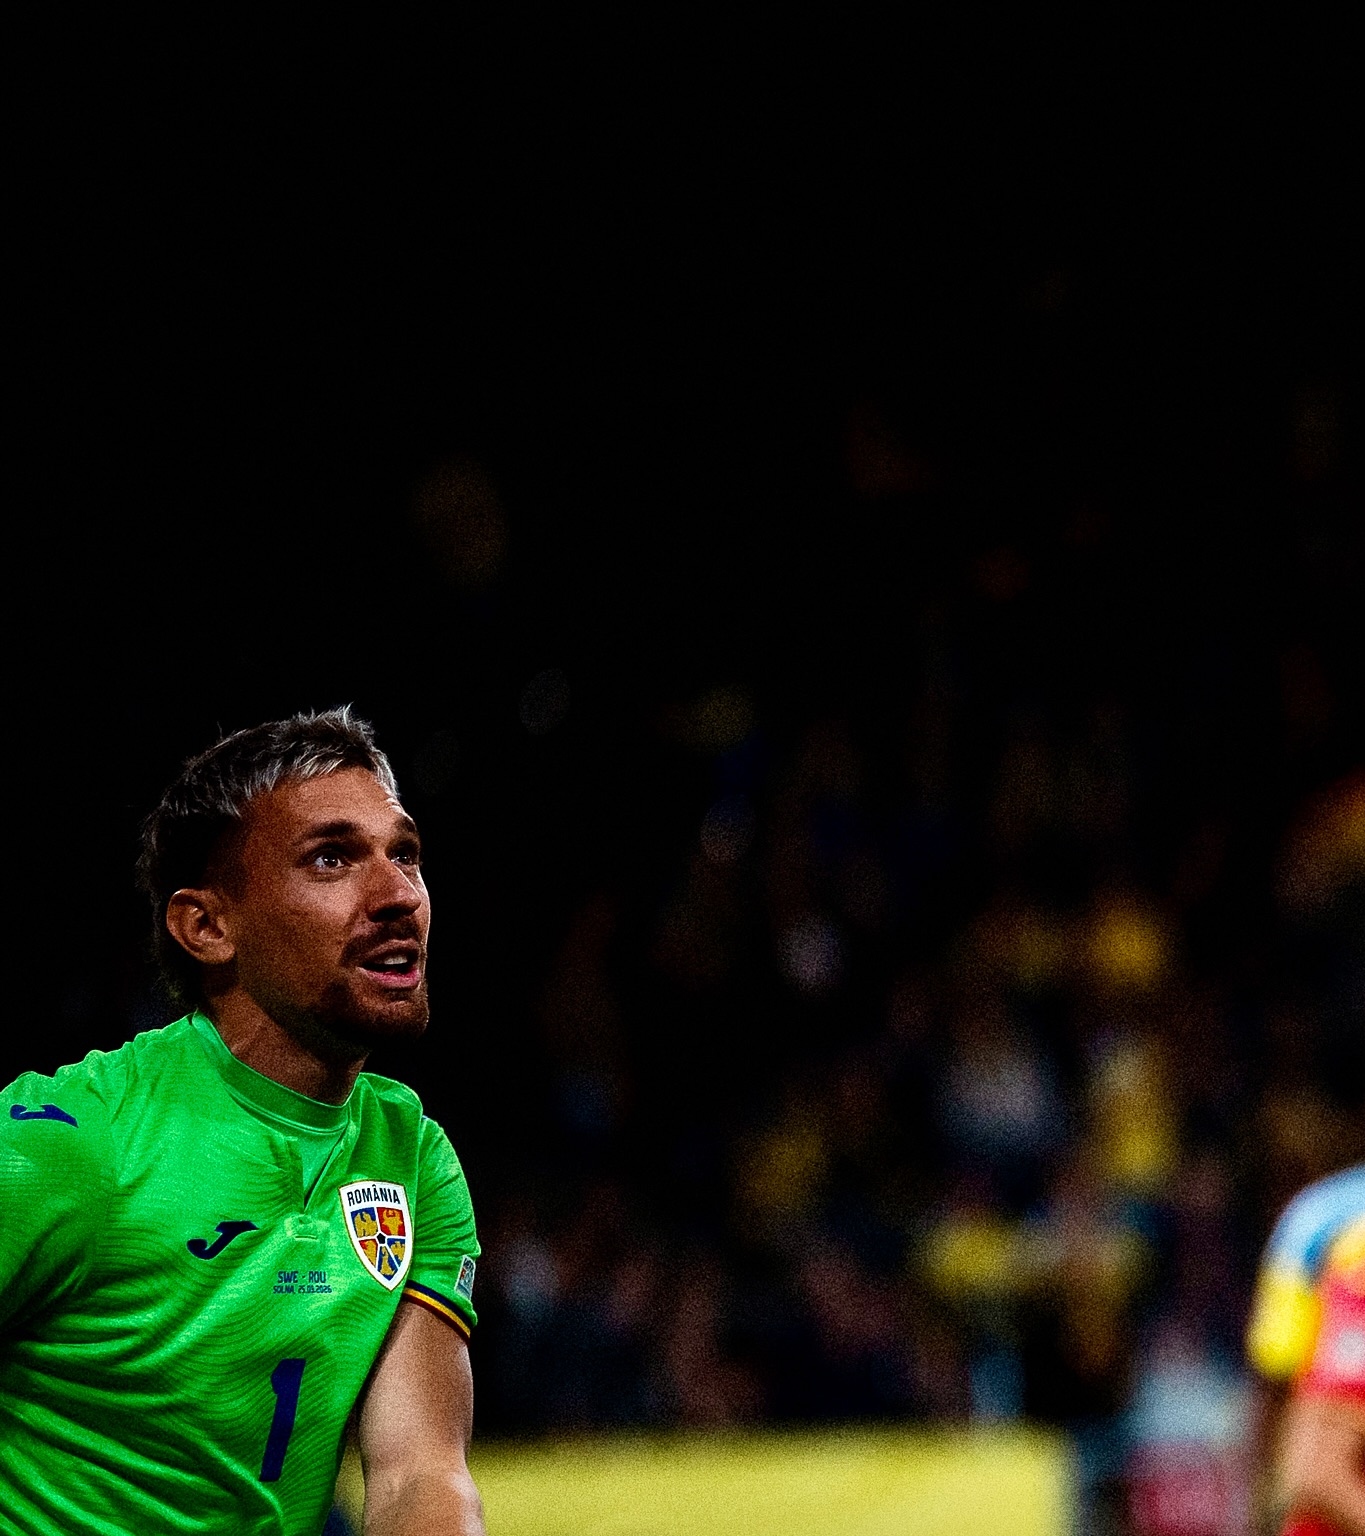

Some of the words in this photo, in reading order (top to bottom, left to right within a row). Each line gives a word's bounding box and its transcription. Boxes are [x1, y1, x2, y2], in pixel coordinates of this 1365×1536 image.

[346, 1184, 401, 1207] ROMÂNIA
[277, 1271, 299, 1283] SWE
[308, 1271, 327, 1283] ROU
[259, 1359, 307, 1482] 1
